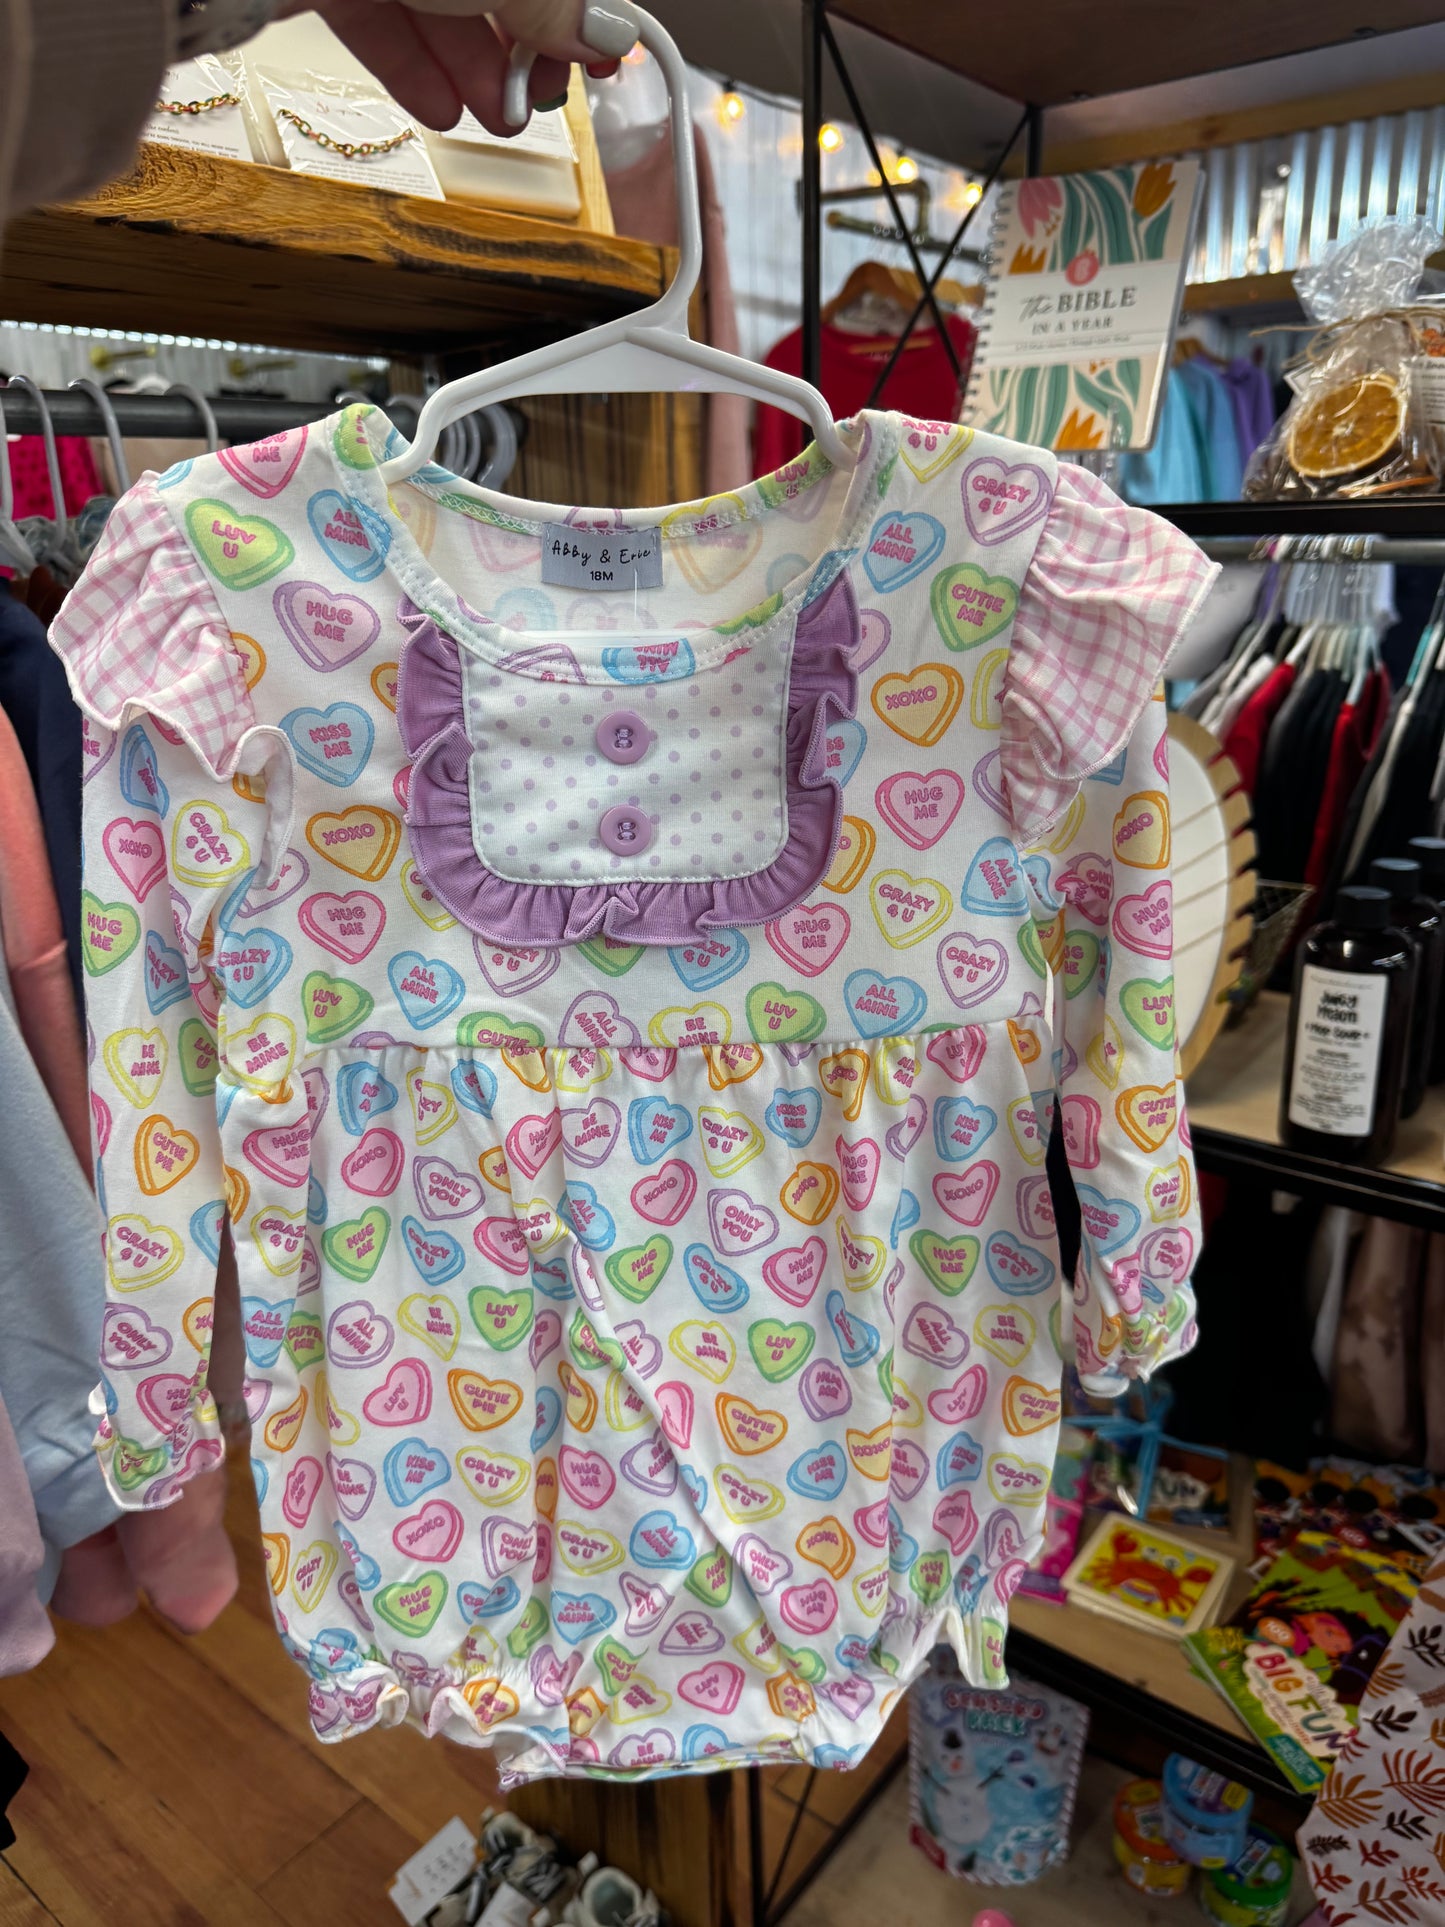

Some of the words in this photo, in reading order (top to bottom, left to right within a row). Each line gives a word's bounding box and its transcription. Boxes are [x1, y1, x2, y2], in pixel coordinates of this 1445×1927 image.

[1019, 294, 1053, 322] The
[1058, 287, 1136, 313] BIBLE
[1032, 322, 1049, 335] IN
[1055, 321, 1066, 333] A
[1072, 315, 1112, 331] YEAR
[925, 435, 937, 451] U
[253, 447, 280, 462] ME
[775, 460, 809, 483] LUV
[971, 475, 1031, 503] CRAZY
[992, 501, 1006, 515] U
[212, 520, 256, 544] LUV
[882, 523, 914, 544] ALL
[223, 543, 238, 558] U
[552, 540, 591, 566] Abby
[600, 549, 610, 563] &
[870, 539, 917, 564] MINE
[590, 571, 613, 580] 18M
[951, 583, 1006, 613] CUTIE
[306, 601, 353, 625] HUG
[956, 604, 986, 627] ME
[314, 623, 345, 642] ME
[885, 685, 937, 711] XOXO
[309, 723, 352, 744] KISS
[323, 741, 353, 759] ME
[904, 786, 943, 805] HUG
[914, 804, 939, 820] ME
[190, 812, 232, 865] CRAZY
[322, 823, 375, 846] XOXO
[194, 849, 210, 862] U
[979, 860, 1007, 900] MINE
[994, 859, 1018, 887] ALL
[878, 883, 935, 913] CRAZY
[327, 906, 366, 921] HUG
[902, 908, 916, 922] U
[1132, 897, 1169, 924] HUG
[88, 912, 122, 935] HUG
[339, 922, 365, 935] ME
[793, 918, 831, 934] HUG
[1149, 914, 1171, 936] ME
[91, 932, 113, 951] ME
[802, 934, 827, 949] ME
[218, 949, 270, 967] CRAZY
[507, 957, 520, 972] U
[697, 954, 712, 968] U
[946, 947, 995, 972] CRAZY
[244, 966, 254, 981] U
[409, 966, 436, 987] ALL
[967, 970, 980, 983] U
[313, 989, 342, 1007] LUV
[401, 978, 439, 1003] MINE
[866, 984, 897, 1002] ALL
[314, 1005, 328, 1018] U
[764, 1001, 797, 1019] LUV
[855, 998, 900, 1019] MINE
[1142, 995, 1173, 1011] LUV
[684, 1017, 706, 1031] BE
[768, 1016, 781, 1030] U
[1155, 1012, 1167, 1025] U
[247, 1032, 271, 1052] BE
[678, 1031, 720, 1048] MINE
[141, 1044, 154, 1058] BE
[246, 1042, 289, 1074] MINE
[131, 1061, 161, 1076] MINE
[197, 1055, 211, 1069] U
[776, 1104, 807, 1116] KISS
[582, 1113, 597, 1130] BE
[653, 1113, 676, 1130] KISS
[702, 1117, 749, 1141] CRAZY
[783, 1117, 807, 1128] ME
[955, 1114, 980, 1132] KISS
[272, 1128, 311, 1148] HUG
[575, 1124, 611, 1147] MINE
[650, 1130, 666, 1143] ME
[951, 1130, 972, 1146] ME
[152, 1132, 188, 1162] CUTIE
[284, 1143, 310, 1161] ME
[722, 1141, 733, 1153] U
[155, 1153, 174, 1172] PIE
[429, 1173, 472, 1197] ONLY
[643, 1176, 678, 1205] XOXO
[944, 1179, 984, 1201] XOXO
[428, 1185, 460, 1207] YOU
[725, 1206, 765, 1232] ONLY
[1082, 1203, 1120, 1228] KISS
[346, 1223, 375, 1249] HUG
[722, 1219, 753, 1242] YOU
[1085, 1221, 1109, 1240] ME
[117, 1227, 168, 1260] CRAZY
[284, 1237, 298, 1252] U
[356, 1242, 375, 1260] ME
[408, 1228, 449, 1259] CRAZY
[133, 1253, 149, 1268] U
[425, 1253, 435, 1267] U
[631, 1249, 657, 1273] HUG
[788, 1251, 814, 1274] HUG
[933, 1247, 967, 1260] HUG
[991, 1243, 1038, 1275] CRAZY
[637, 1264, 655, 1281] ME
[796, 1267, 814, 1284] ME
[941, 1260, 963, 1273] ME
[1010, 1264, 1021, 1276] U
[252, 1310, 283, 1325] ALL
[997, 1315, 1015, 1328] BE
[245, 1324, 285, 1341] MINE
[353, 1318, 376, 1340] ALL
[990, 1328, 1024, 1345] MINE
[336, 1324, 371, 1355] MINE
[702, 1332, 718, 1346] BE
[697, 1346, 728, 1363] MINE
[731, 1408, 776, 1434] CUTIE
[736, 1424, 761, 1442] PIE
[406, 1455, 436, 1471] KISS
[808, 1455, 836, 1475] KISS
[405, 1470, 425, 1483] ME
[815, 1468, 834, 1482] ME
[406, 1516, 445, 1545] XOXO
[400, 1586, 432, 1607] HUG
[800, 1590, 827, 1607] HUG
[409, 1600, 430, 1617] ME
[565, 1602, 591, 1611] ALL
[806, 1602, 825, 1615] ME
[558, 1612, 595, 1623] MINE
[1254, 1653, 1303, 1693] BIG
[1287, 1694, 1350, 1749] FUN
